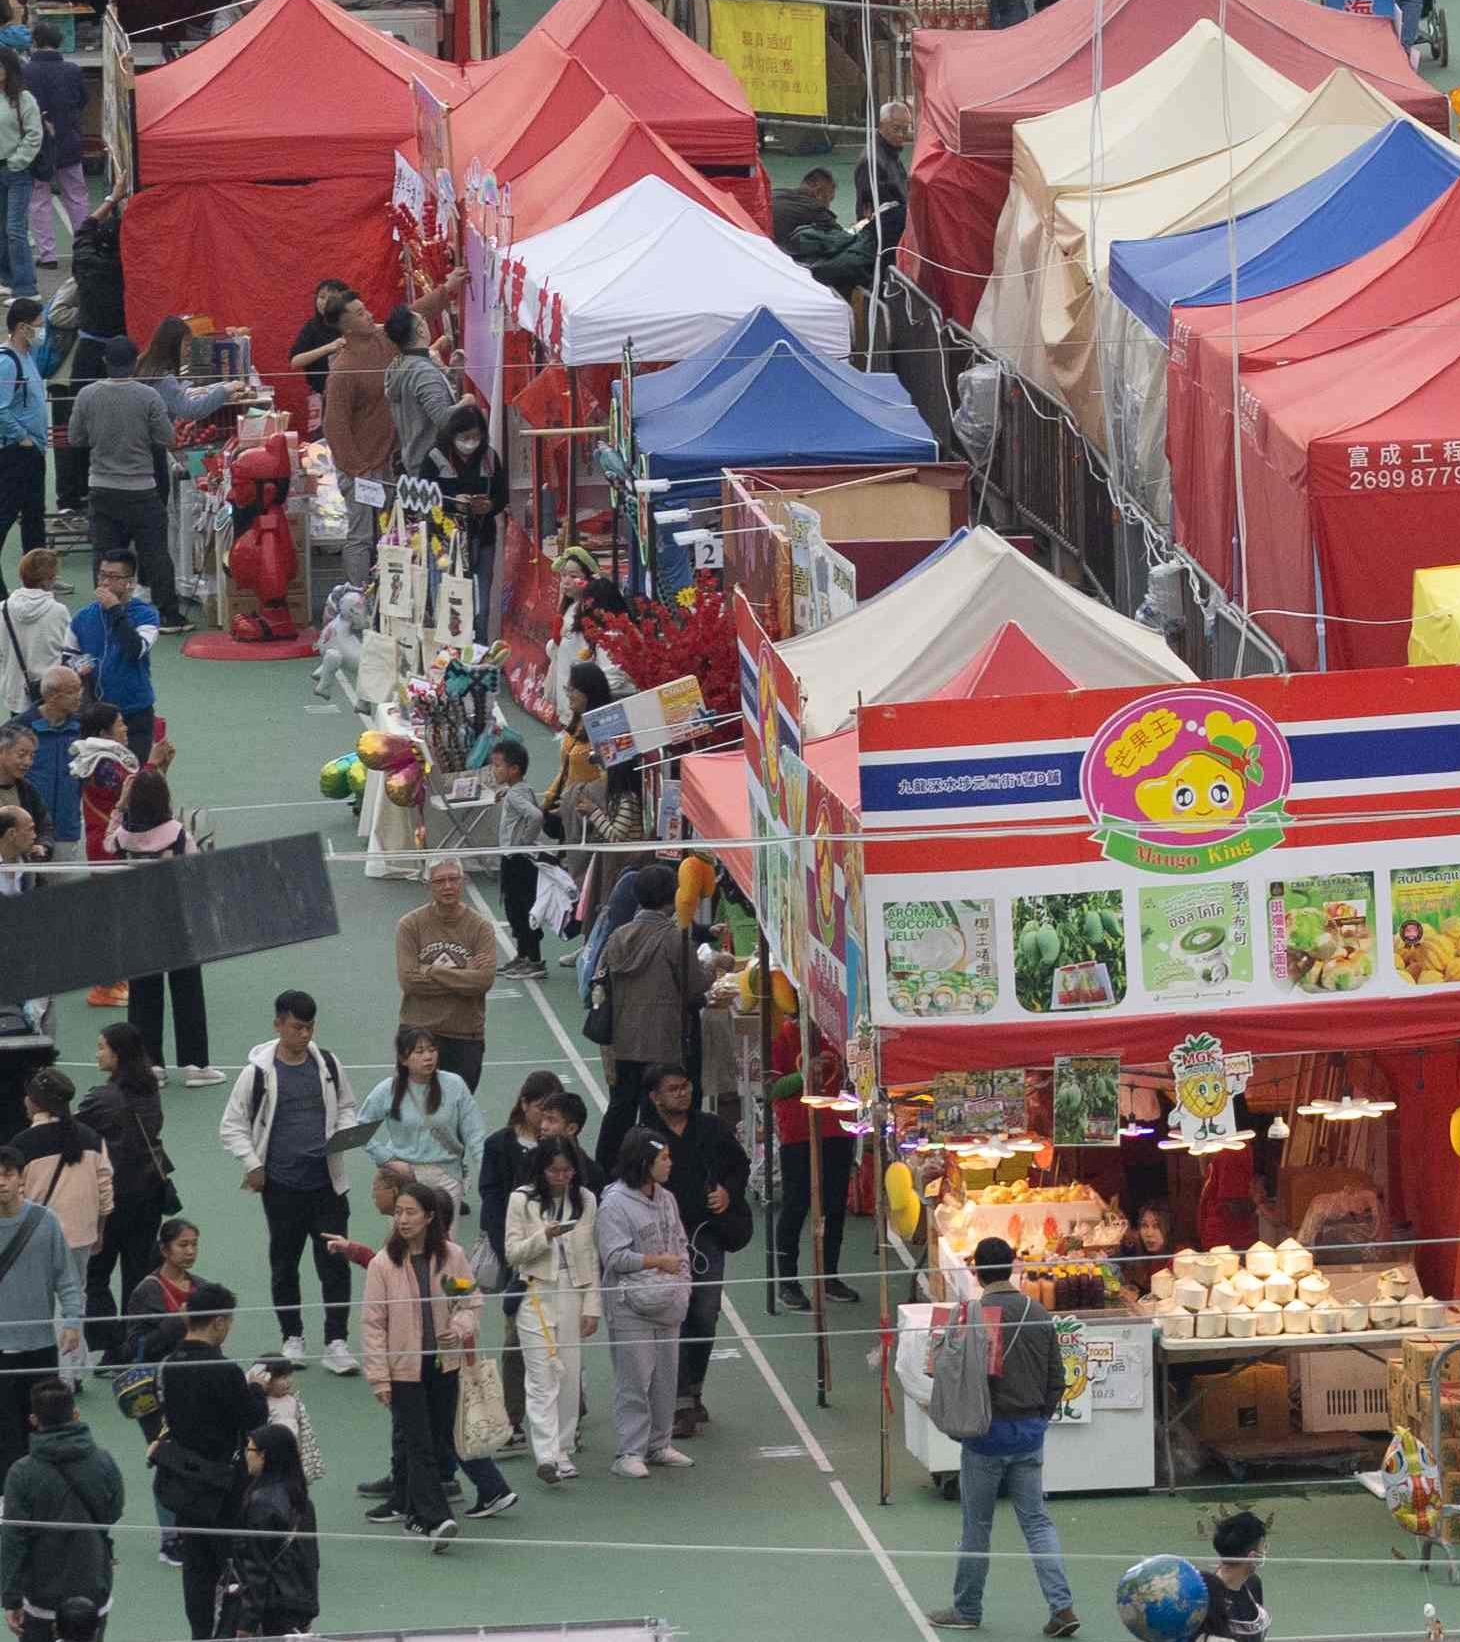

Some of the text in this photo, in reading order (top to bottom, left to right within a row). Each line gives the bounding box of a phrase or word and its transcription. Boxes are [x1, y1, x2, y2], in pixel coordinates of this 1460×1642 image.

[1350, 470, 1405, 490] 2699
[702, 544, 715, 565] 2
[1114, 715, 1174, 771] 芒果王
[1136, 838, 1255, 869] Mango King
[888, 907, 942, 919] AROMA
[888, 918, 953, 929] COCONUT
[888, 931, 924, 942] JELLY
[1182, 1051, 1216, 1067] MGK
